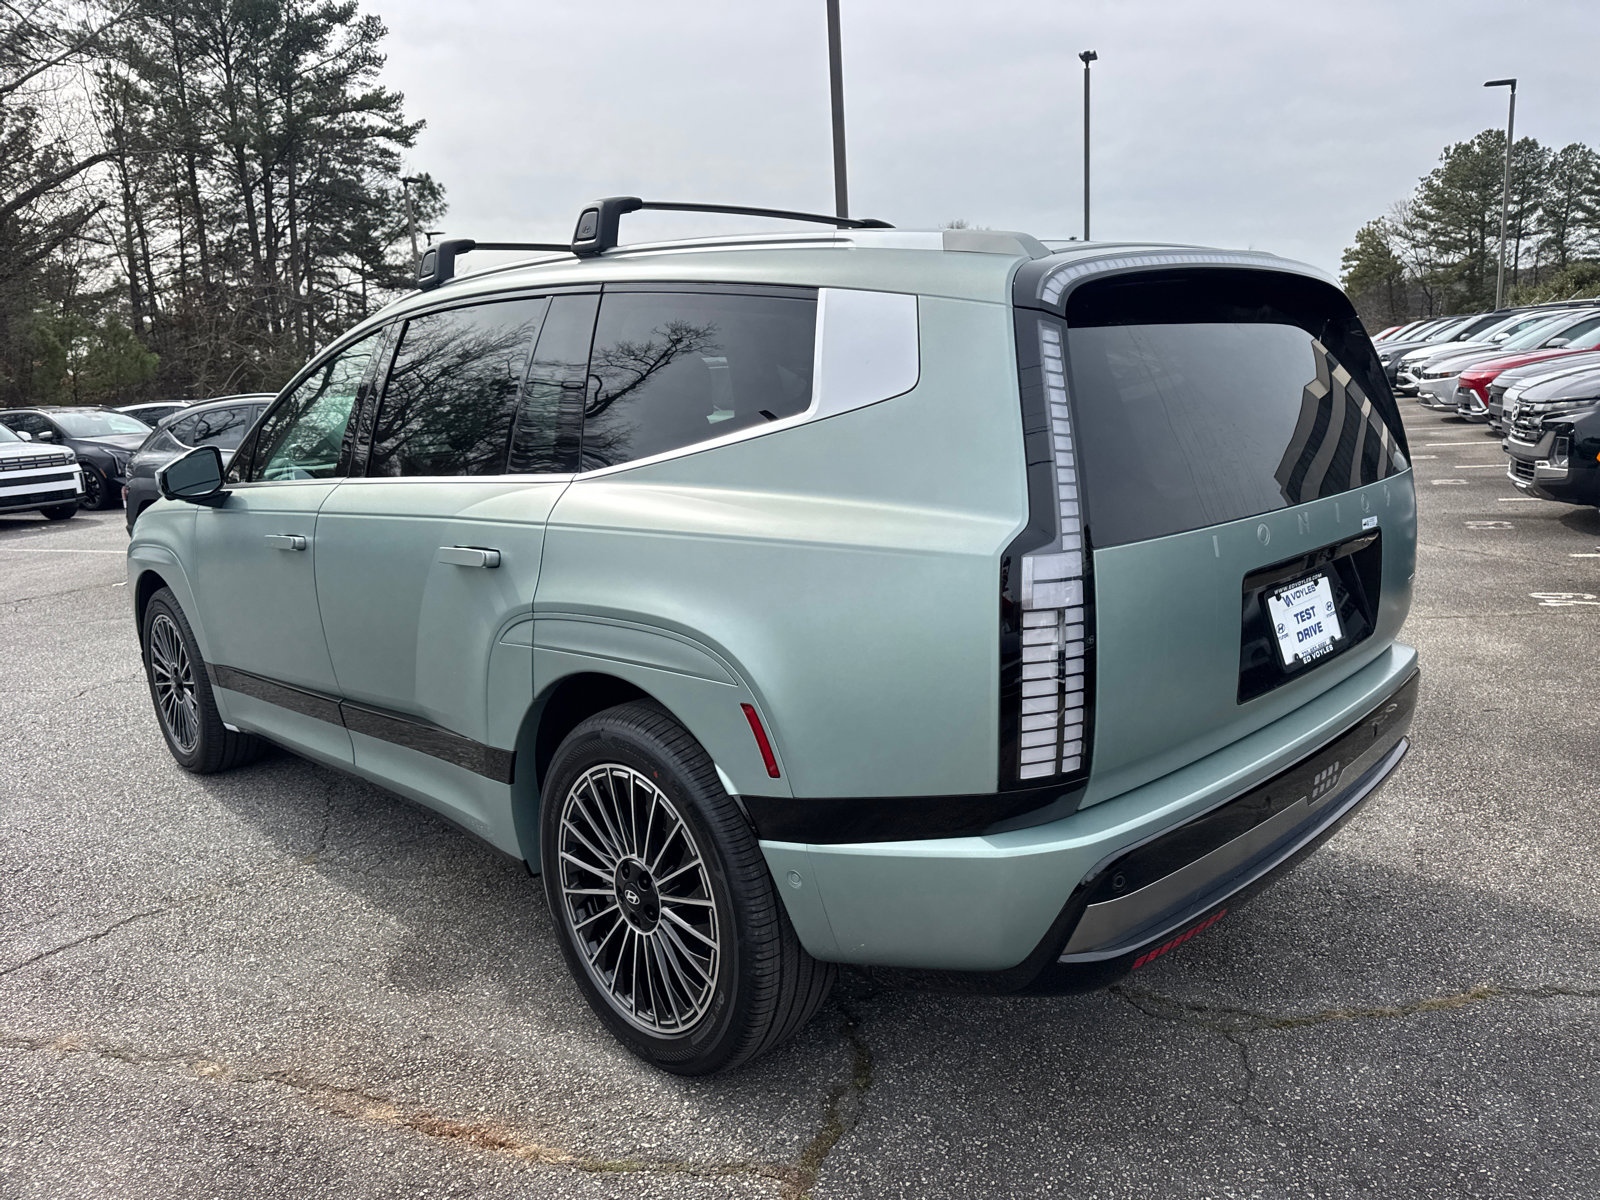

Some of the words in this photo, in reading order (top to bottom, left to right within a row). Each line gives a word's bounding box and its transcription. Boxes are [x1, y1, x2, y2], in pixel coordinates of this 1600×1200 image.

[1212, 493, 1371, 558] IONIQ
[1290, 584, 1316, 601] VOYLES
[1293, 605, 1316, 625] TEST
[1296, 620, 1324, 643] DRIVE
[1302, 655, 1312, 665] ED
[1311, 644, 1334, 660] VOYLES
